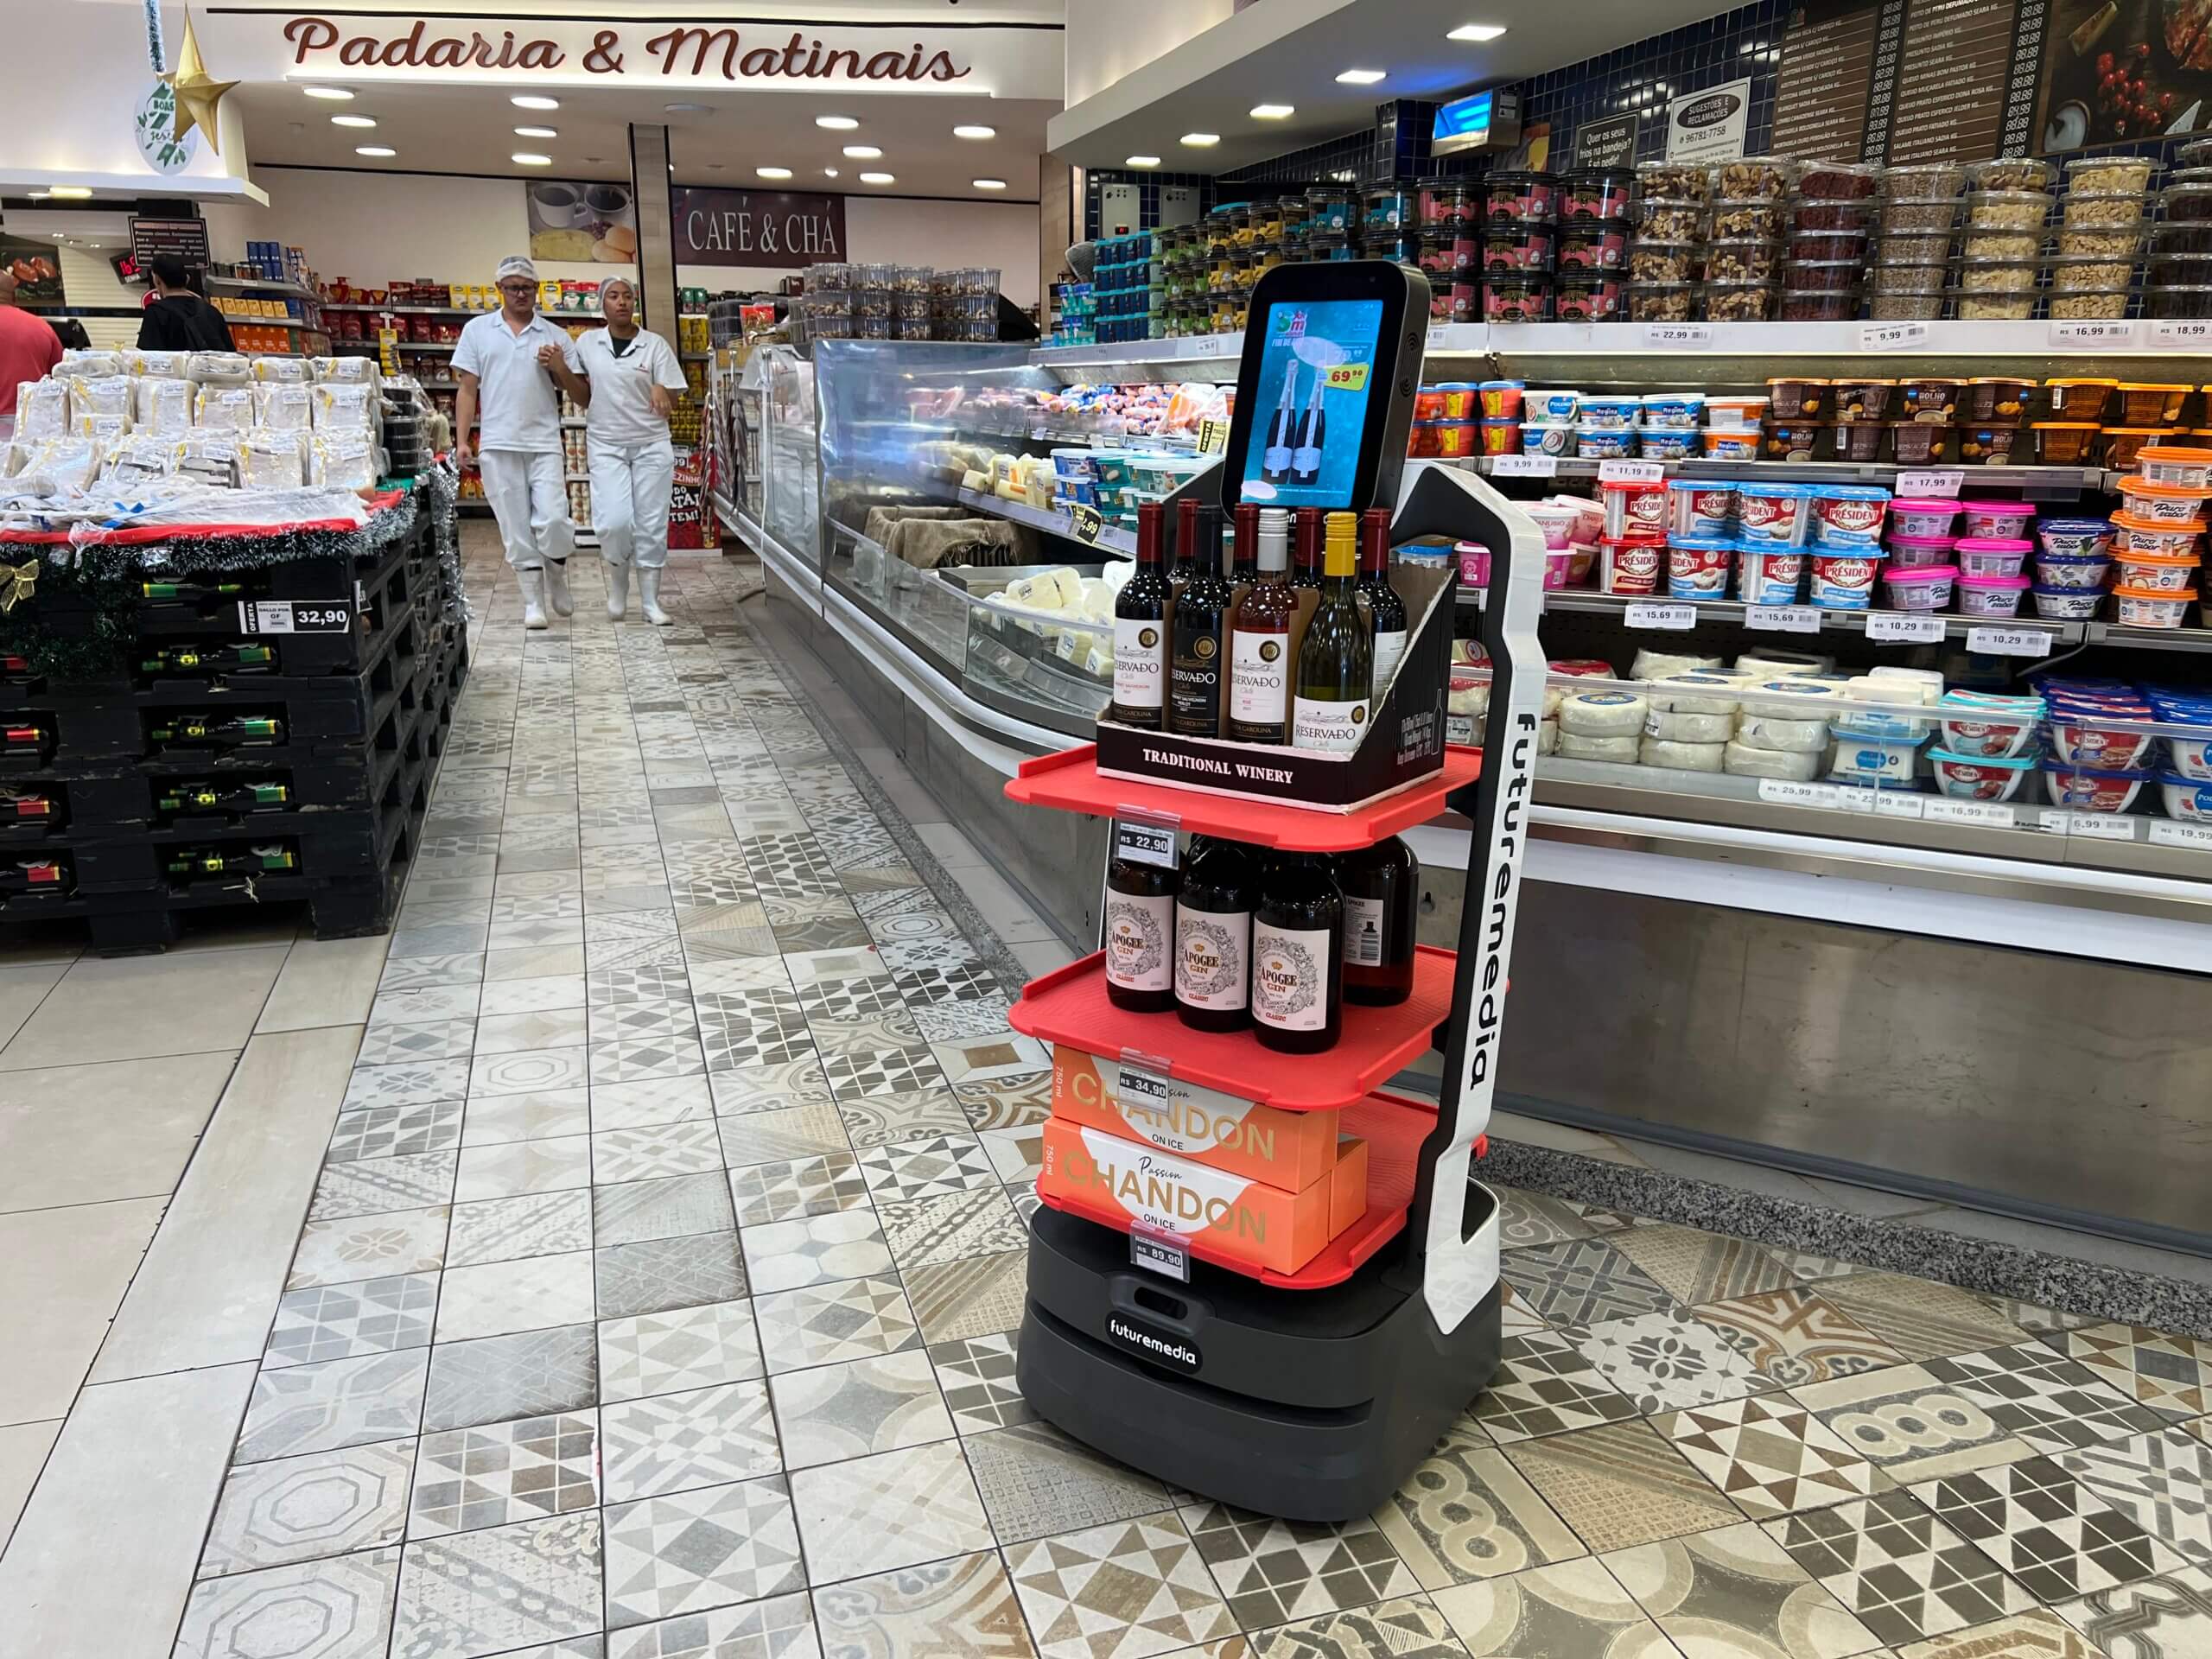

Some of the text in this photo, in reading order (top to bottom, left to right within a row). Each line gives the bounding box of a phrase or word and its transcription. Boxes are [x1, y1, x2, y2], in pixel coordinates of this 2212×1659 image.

[283, 18, 972, 81] Padaria & Matinais
[688, 196, 838, 255] CAFÉ & CHÁ
[1919, 479, 1945, 487] 17,99
[1830, 507, 1878, 520] PRÉSIDENT
[2154, 503, 2185, 512] Puro
[2131, 534, 2156, 544] Puro
[1826, 566, 1872, 578] PRÉSIDENT
[247, 603, 257, 632] OFERTA
[297, 610, 347, 626] 32,90
[1646, 611, 1670, 620] 15,69
[1768, 613, 1793, 622] 15,69
[1890, 622, 1916, 631] 10,29
[1993, 635, 2021, 645] 10,29
[1296, 724, 1355, 740] RESERVADO
[1143, 748, 1294, 784] TRADITIONAL WINERY
[1136, 836, 1167, 851] 22,90
[1471, 713, 1535, 1090] futuremedia
[1112, 931, 1144, 949] APOGEE
[1117, 946, 1134, 956] GIN
[1185, 948, 1219, 968] APOGEE
[1190, 964, 1209, 975] GIN
[1261, 965, 1298, 987] APOGEE
[1267, 982, 1286, 993] GIN
[1168, 1089, 1190, 1098] sion
[1152, 1134, 1183, 1150] ON ICE
[1139, 1156, 1182, 1179] Passion
[1064, 1150, 1266, 1244] CHANDON
[1143, 1213, 1176, 1230] ON ICE
[1110, 1319, 1197, 1365] futuremedia
